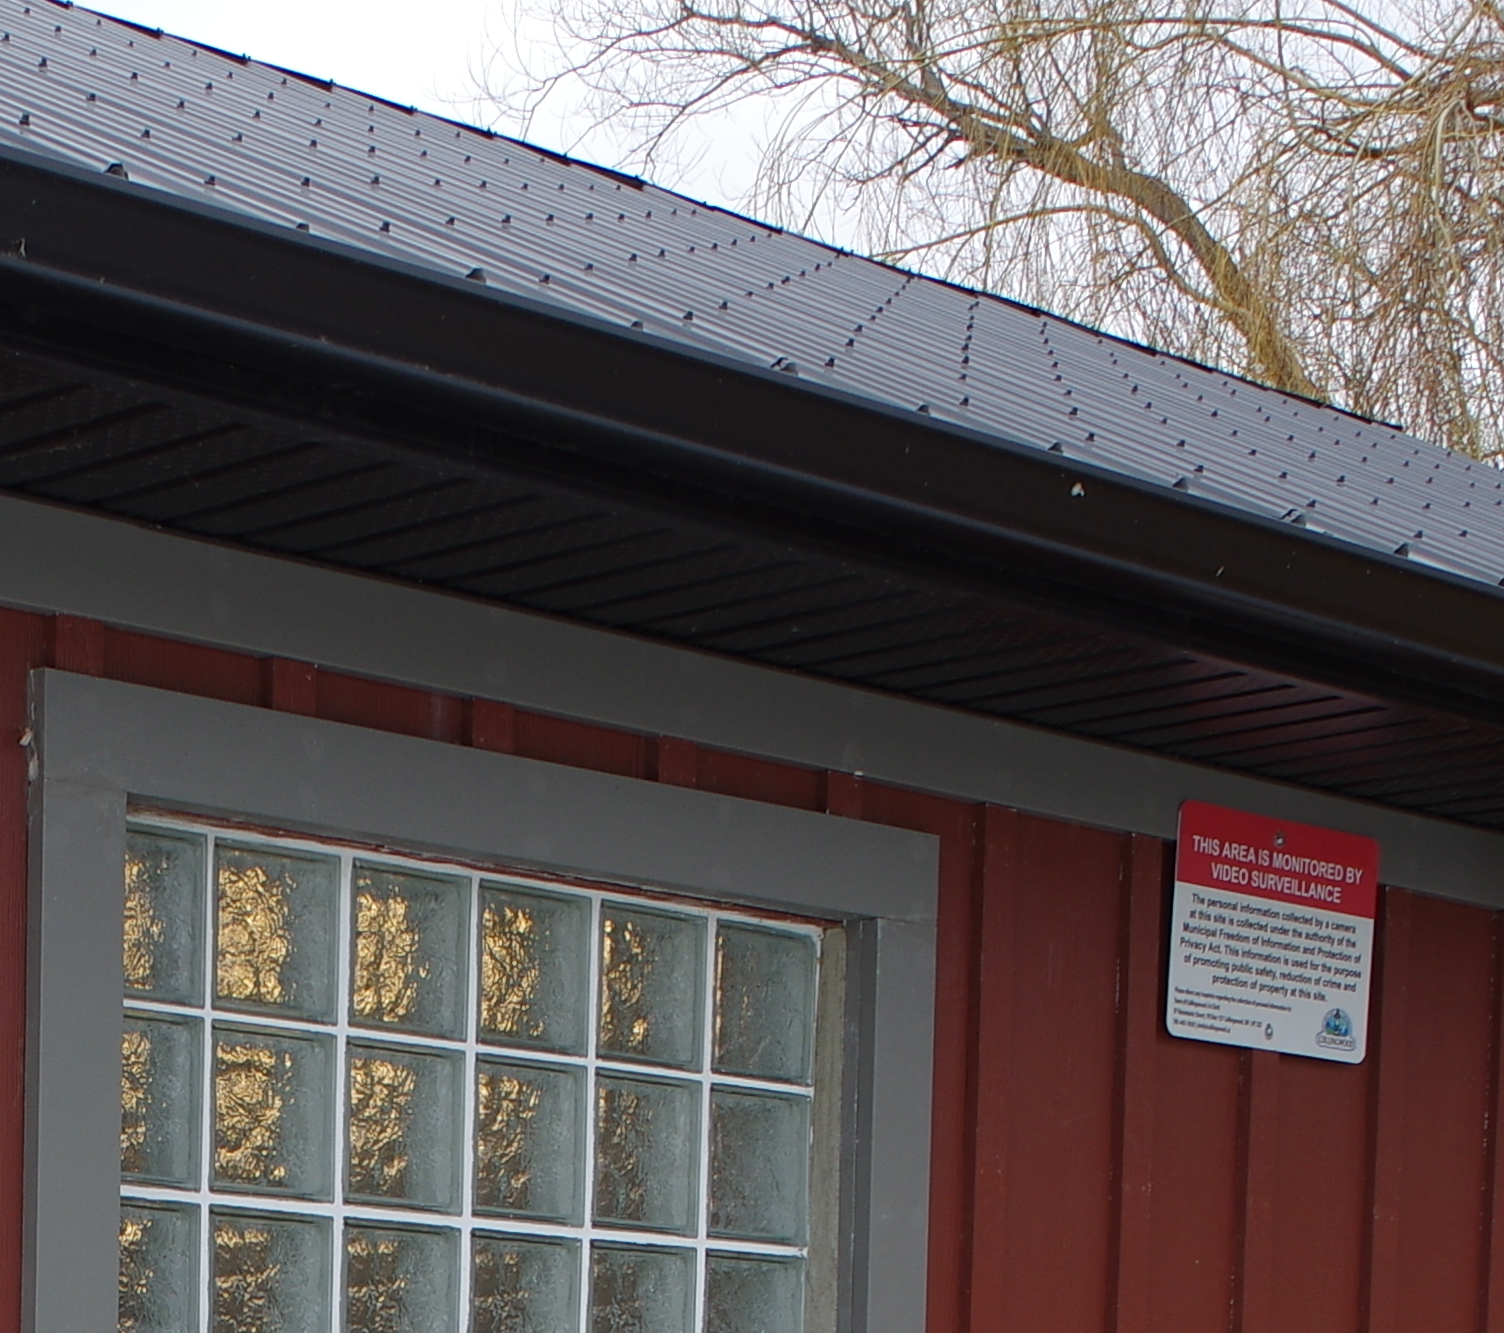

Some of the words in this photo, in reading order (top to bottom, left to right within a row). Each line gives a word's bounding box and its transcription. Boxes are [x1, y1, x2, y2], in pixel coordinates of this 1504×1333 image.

[1192, 834, 1220, 856] THIS
[1222, 841, 1256, 865] AREA
[1258, 848, 1270, 867] IS
[1272, 851, 1344, 881] MONITORED
[1346, 866, 1363, 885] BY
[1211, 862, 1249, 885] VIDEO
[1250, 870, 1342, 904] SURVEILLANCE
[1188, 910, 1196, 919] at
[1198, 910, 1211, 921] this
[1213, 914, 1226, 925] site
[1228, 916, 1234, 926] is
[1236, 918, 1268, 933] collected
[1270, 925, 1290, 936] under
[1292, 928, 1303, 938] the
[1304, 932, 1335, 947] authority
[1336, 937, 1344, 946] of
[1345, 938, 1356, 949] the
[1192, 893, 1205, 905] The
[1207, 898, 1238, 911] personal
[1239, 902, 1281, 919] information
[1282, 912, 1313, 926] collected
[1315, 917, 1323, 930] by
[1325, 921, 1330, 929] a
[1331, 922, 1356, 934] camera
[1180, 936, 1206, 953] Privacy
[1208, 942, 1221, 954] Act.
[1224, 944, 1239, 957] This
[1241, 948, 1281, 965] information
[1283, 955, 1289, 966] is
[1291, 959, 1308, 970] used
[1310, 960, 1320, 970] for
[1321, 962, 1332, 974] the
[1333, 966, 1361, 979] purpose
[1183, 922, 1217, 939] Municipal
[1219, 928, 1250, 943] Freedom
[1252, 936, 1260, 945] of
[1261, 936, 1301, 953] Information
[1302, 945, 1316, 956] and
[1317, 946, 1352, 963] Protection
[1354, 954, 1361, 964] of
[1183, 953, 1191, 963] of
[1193, 956, 1229, 973] promoting
[1231, 963, 1253, 974] public
[1255, 967, 1278, 981] safety,
[1279, 971, 1312, 985] reduction
[1314, 976, 1321, 986] of
[1323, 979, 1341, 990] crime
[1343, 983, 1356, 992] and
[1212, 975, 1248, 988] protection
[1250, 980, 1258, 990] of
[1259, 984, 1288, 998] property
[1290, 988, 1297, 997] at
[1298, 988, 1311, 999] this
[1313, 992, 1327, 1002] site.
